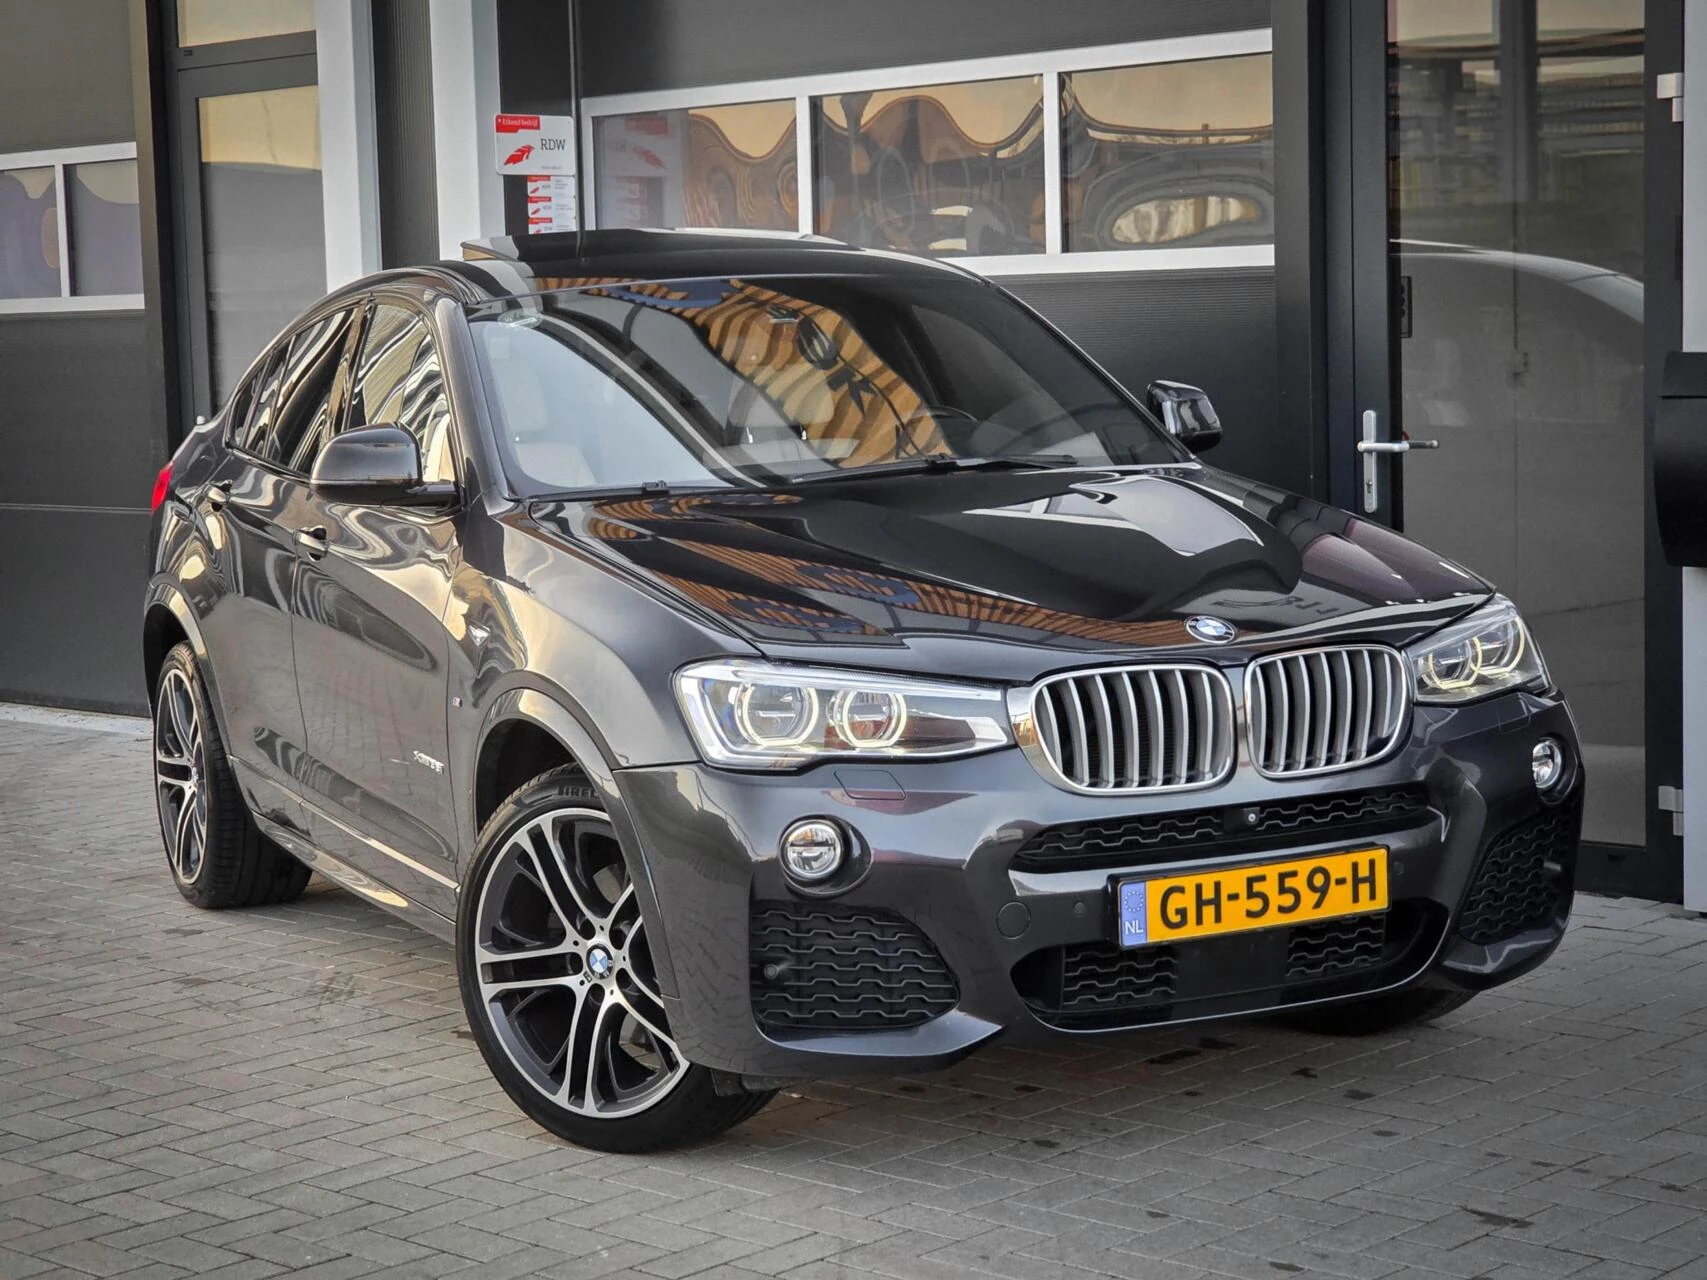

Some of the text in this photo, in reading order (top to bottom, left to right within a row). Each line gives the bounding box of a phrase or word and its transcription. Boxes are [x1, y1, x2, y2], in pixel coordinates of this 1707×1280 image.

[540, 138, 566, 151] RDW
[1159, 858, 1377, 931] GH-559-H
[1124, 919, 1144, 935] NL
